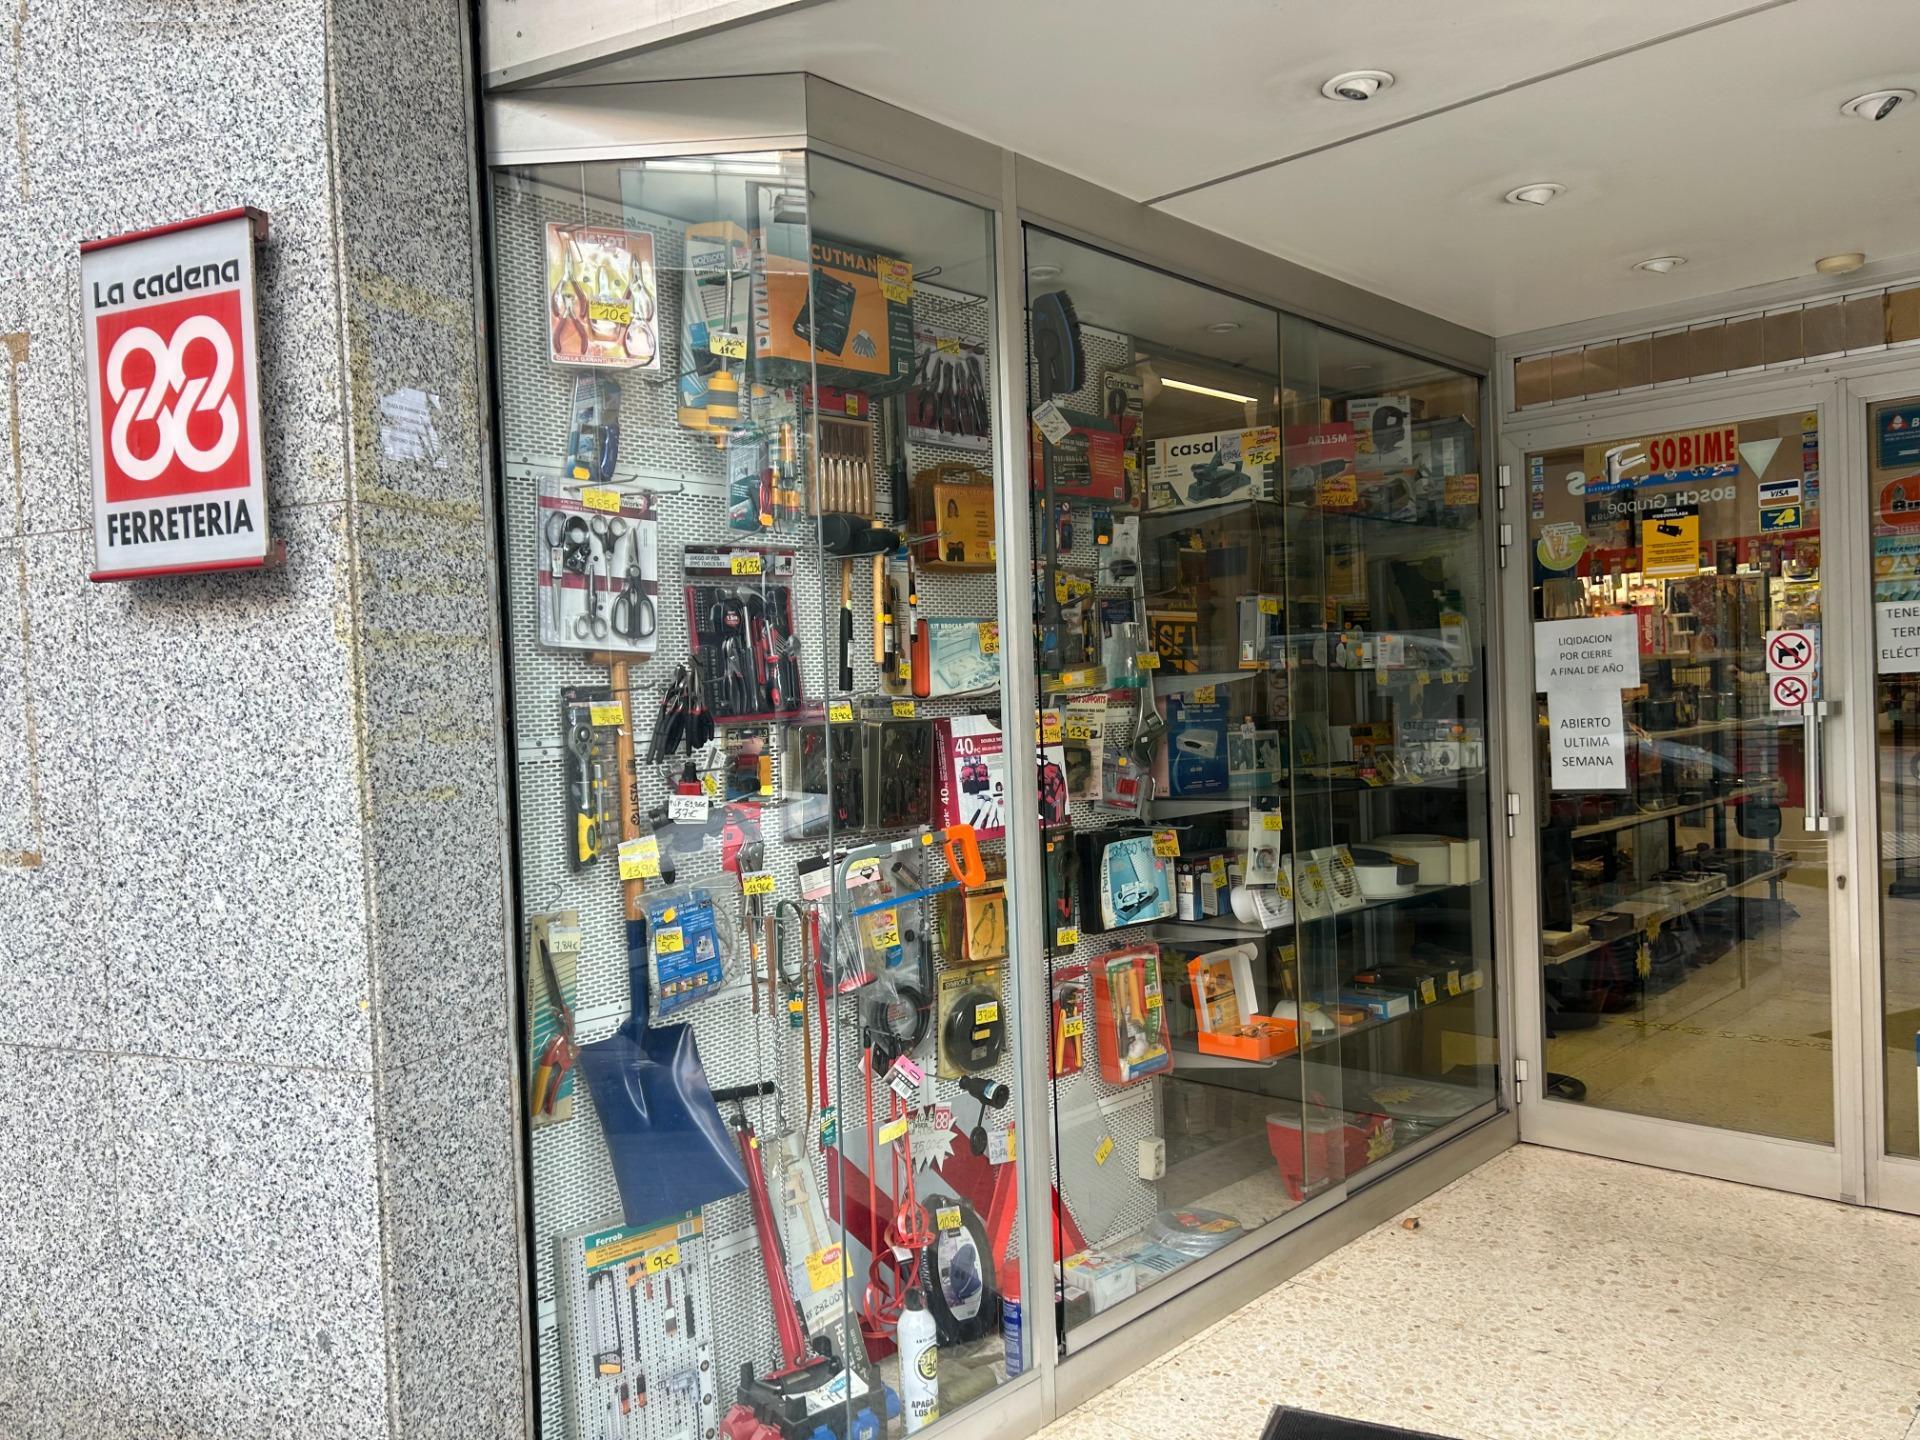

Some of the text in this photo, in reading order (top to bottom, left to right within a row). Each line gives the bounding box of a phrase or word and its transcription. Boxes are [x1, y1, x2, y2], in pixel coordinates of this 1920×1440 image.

[810, 243, 877, 273] CUTMAN
[93, 258, 239, 309] La cadena
[1170, 435, 1218, 457] casal
[1650, 430, 1735, 471] SOBIME
[1770, 489, 1789, 498] VISA
[107, 498, 254, 548] FERRETERIA
[1558, 634, 1612, 646] LIQIDACION
[1560, 649, 1613, 661] POR CIERRE
[1550, 662, 1624, 676] A FINAL DE AÑO
[1560, 717, 1611, 729] ABIERTO
[955, 738, 974, 755] 40
[1564, 737, 1610, 748] ULTIMA
[1562, 756, 1614, 767] SEMANA
[653, 1253, 674, 1269] 9€
[911, 1399, 935, 1409] APAGA
[914, 1408, 929, 1417] LOS
